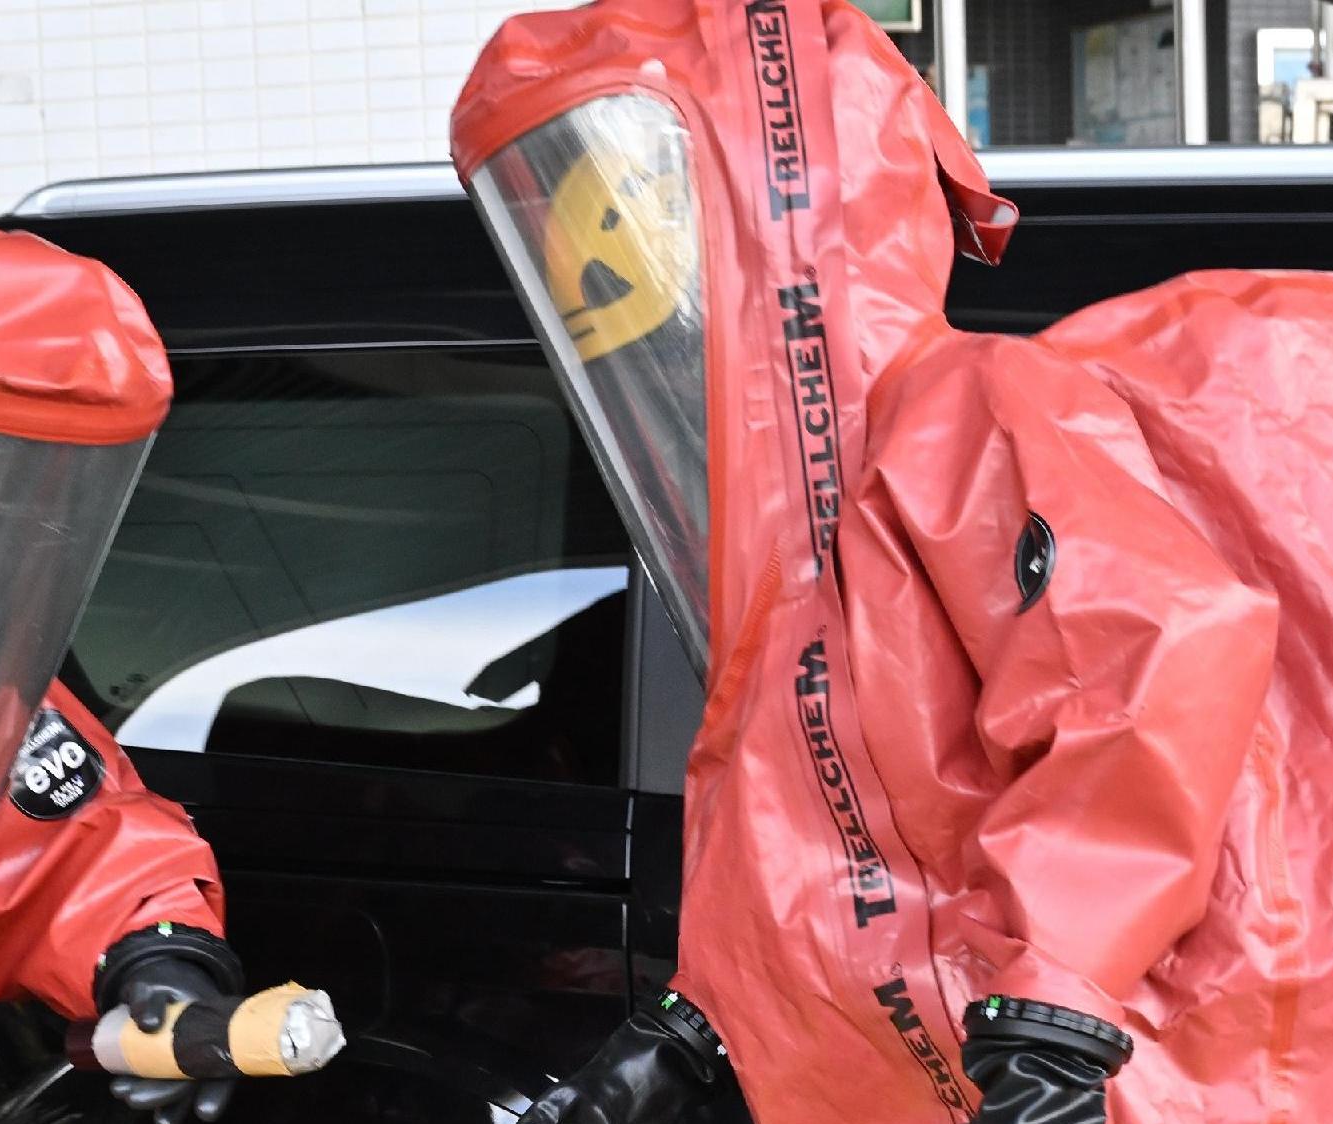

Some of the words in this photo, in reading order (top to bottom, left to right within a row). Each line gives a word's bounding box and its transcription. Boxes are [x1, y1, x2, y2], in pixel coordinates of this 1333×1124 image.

[777, 281, 841, 577] RELLCHEM
[25, 741, 86, 794] evo
[796, 638, 897, 929] TRELLCHEM
